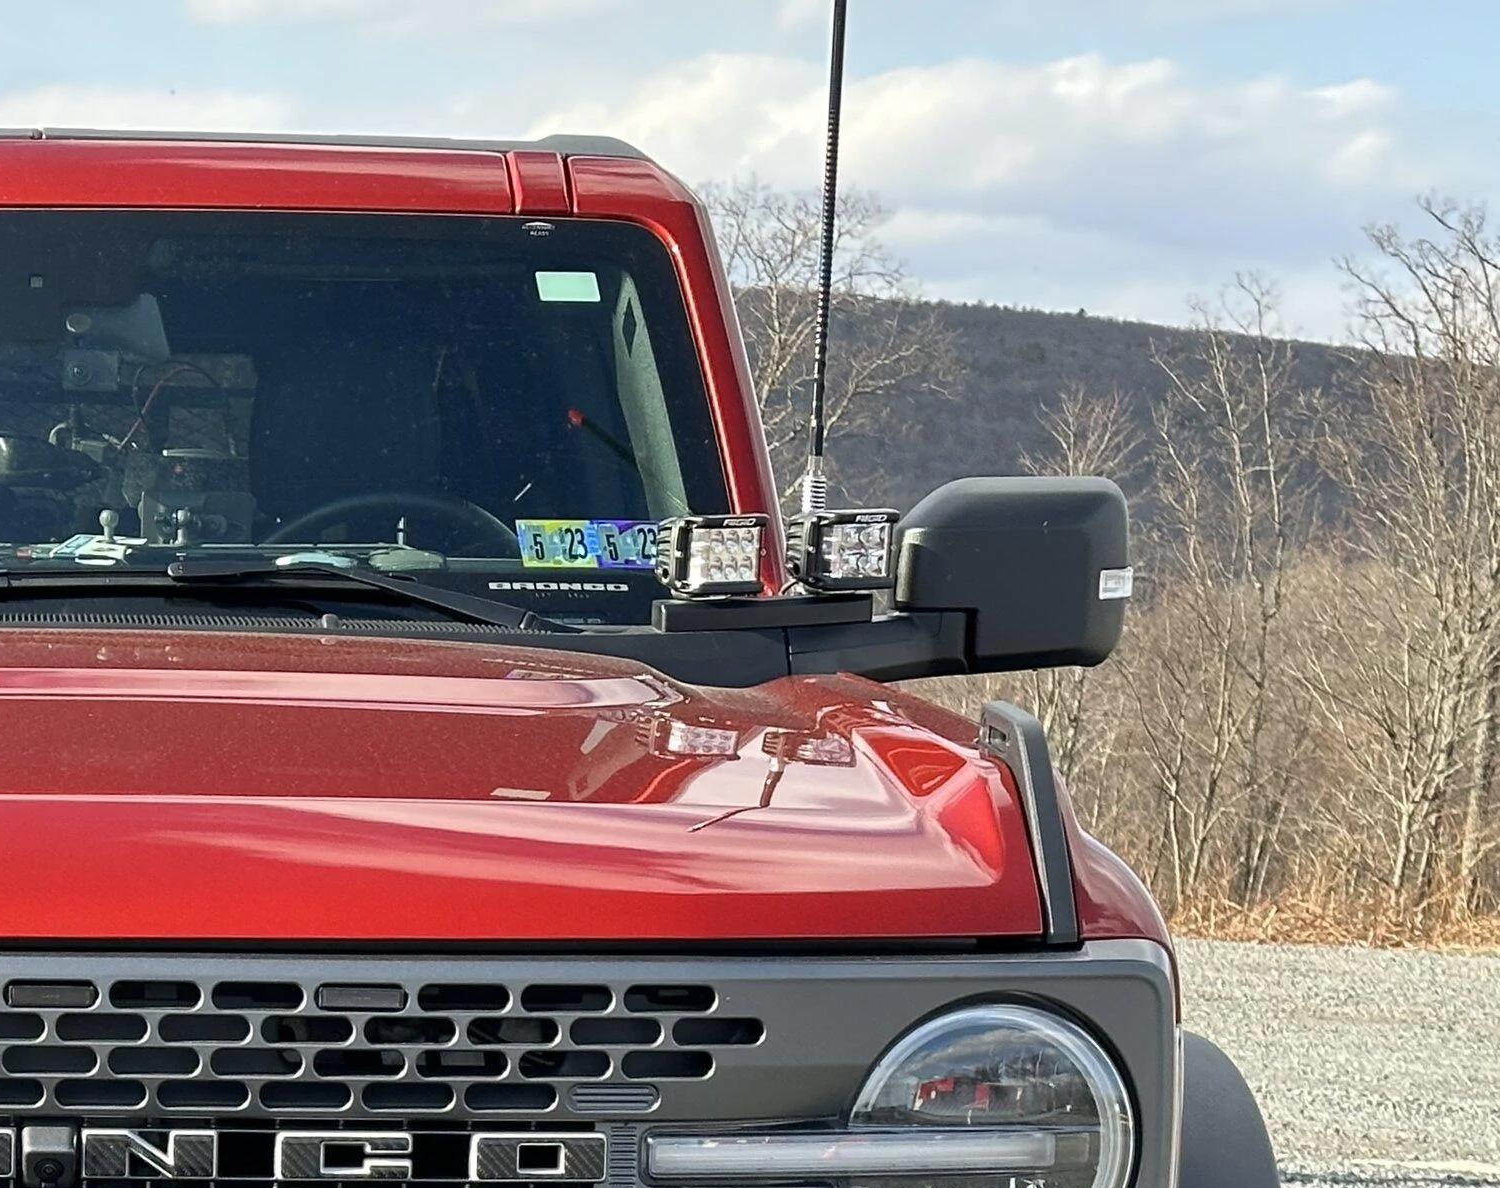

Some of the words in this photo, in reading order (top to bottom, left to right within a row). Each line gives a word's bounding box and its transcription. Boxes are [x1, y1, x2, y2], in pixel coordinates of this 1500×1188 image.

[533, 533, 545, 560] 5
[565, 527, 589, 560] 23
[605, 534, 619, 561] 5
[487, 581, 630, 592] BRONCO
